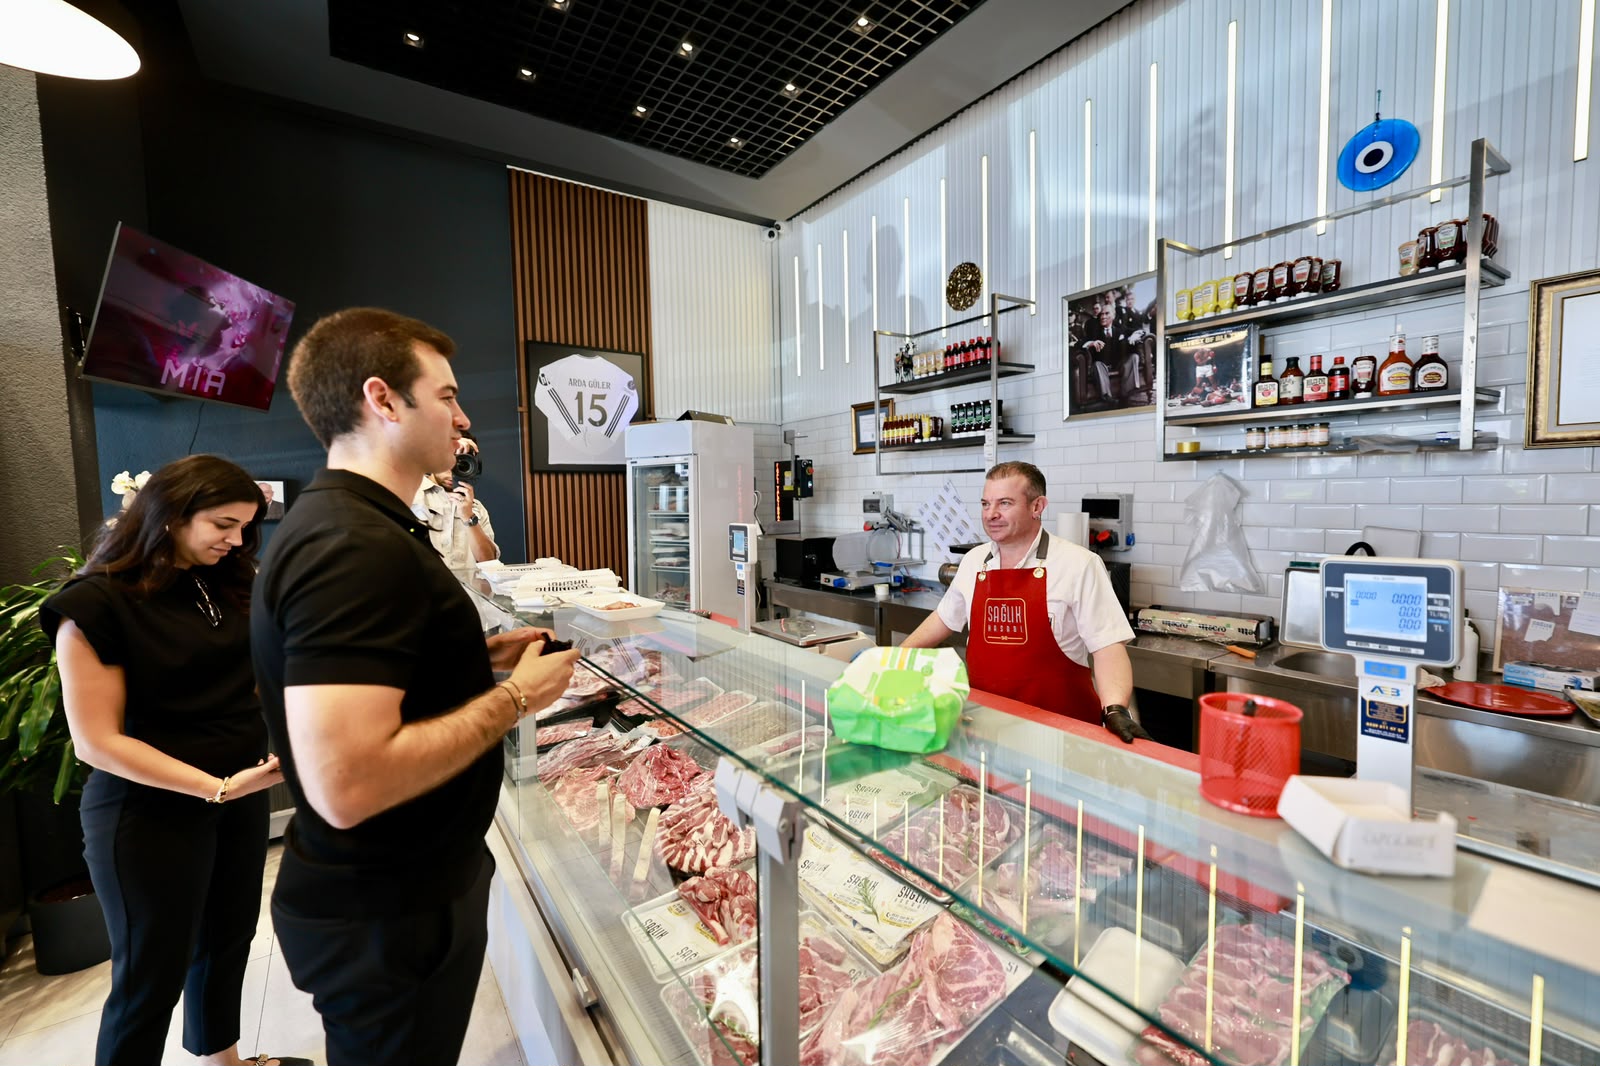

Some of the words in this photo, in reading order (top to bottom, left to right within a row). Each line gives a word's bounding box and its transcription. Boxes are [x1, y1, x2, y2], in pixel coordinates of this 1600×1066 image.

[568, 378, 587, 388] ARDA
[588, 379, 611, 390] GÜLER
[575, 391, 608, 427] 15
[987, 603, 1022, 624] SAĞLIK
[1433, 624, 1444, 632] TL
